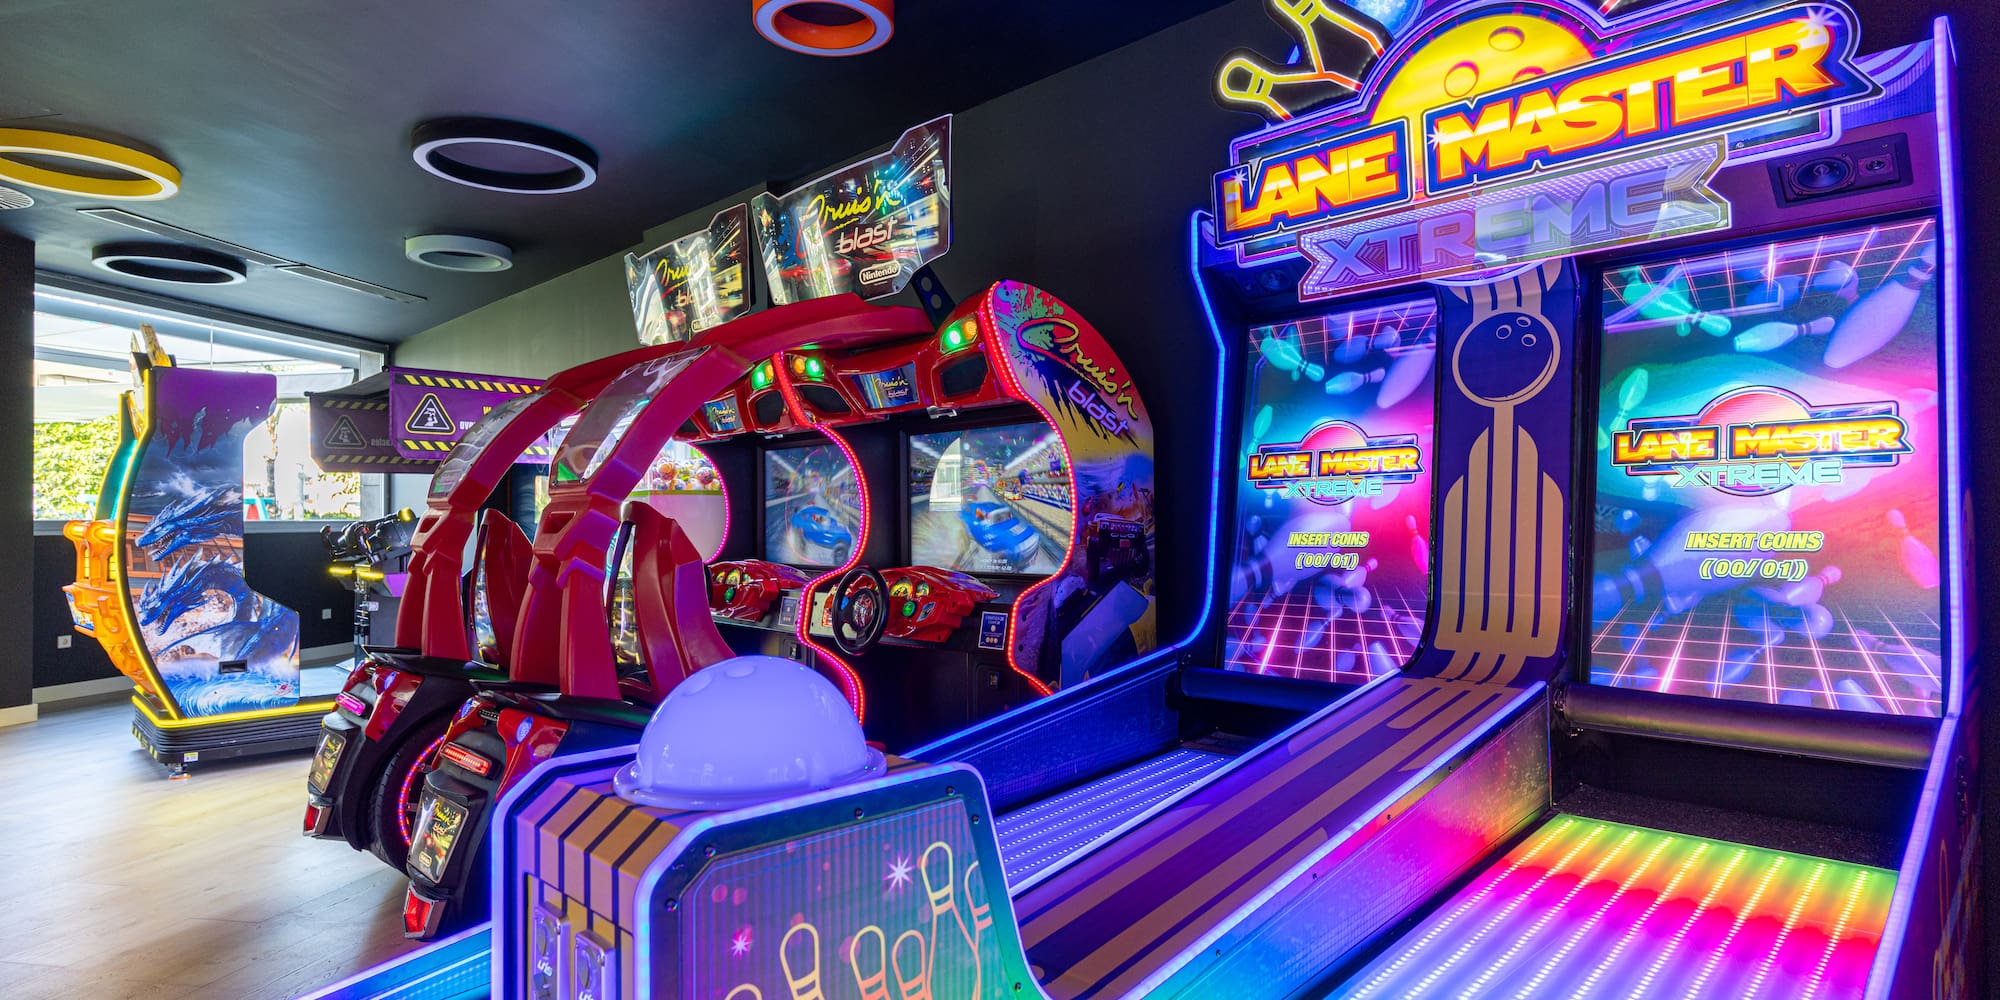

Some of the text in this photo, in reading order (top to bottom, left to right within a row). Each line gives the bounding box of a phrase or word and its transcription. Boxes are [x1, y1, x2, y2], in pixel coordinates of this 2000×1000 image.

[1221, 18, 1840, 233] LANE MASTER
[836, 215, 898, 254] blast
[1317, 161, 1696, 286] XTREME
[862, 265, 898, 282] Nintendo
[1068, 380, 1129, 436] blast
[1615, 419, 1905, 463] LANE MASTER
[1249, 447, 1420, 479] LANE MASTER
[1672, 460, 1843, 488] XTREME
[1284, 478, 1384, 498] XTREME
[1288, 532, 1370, 548] INSERT COINS
[1684, 531, 1825, 551] INSERT COINS
[1699, 558, 1809, 580] (00/01)
